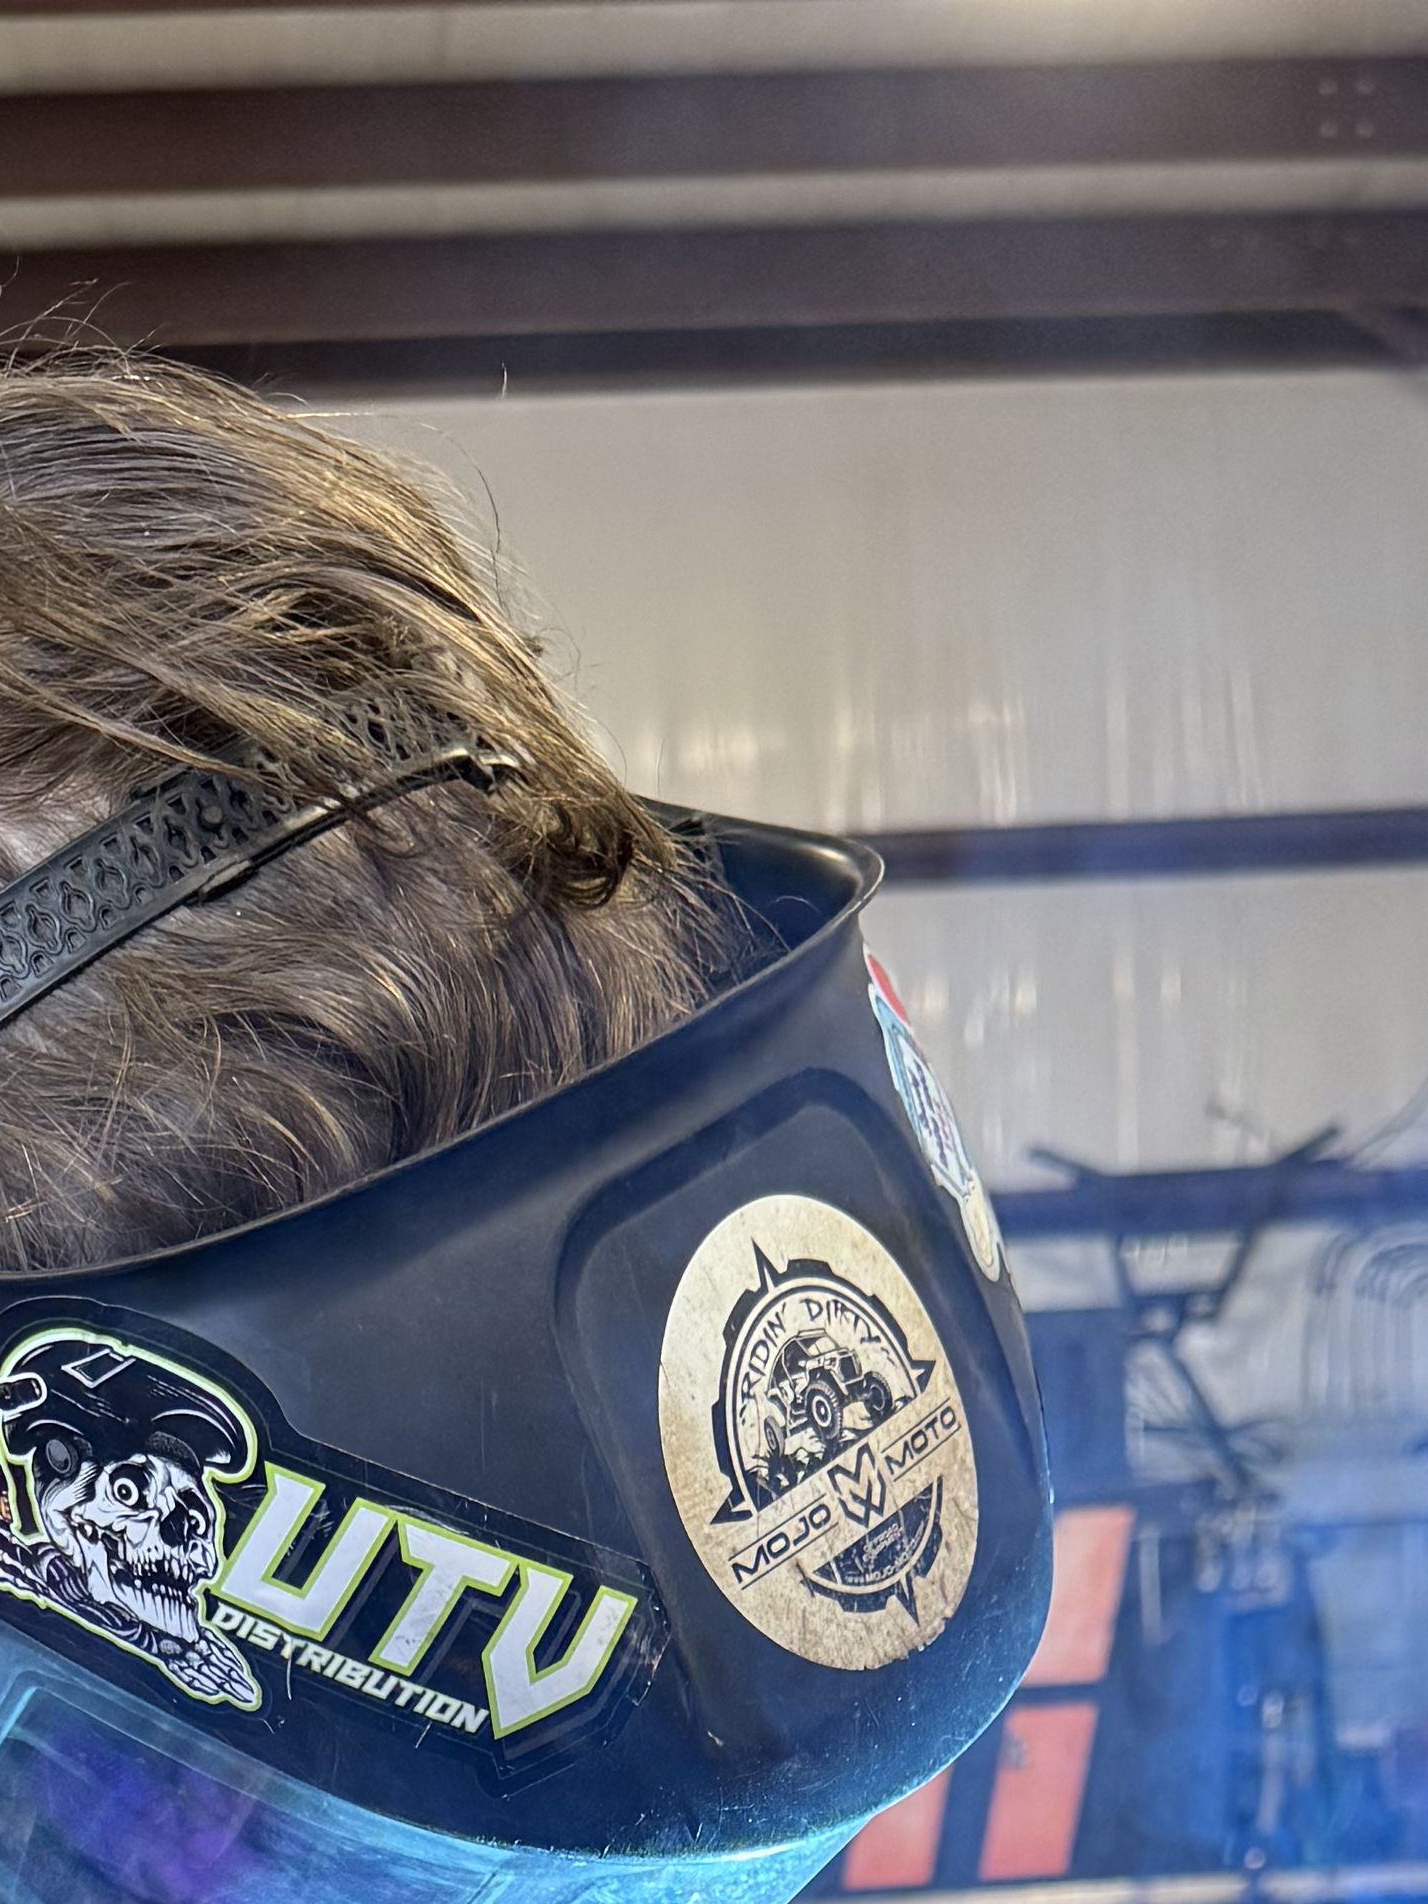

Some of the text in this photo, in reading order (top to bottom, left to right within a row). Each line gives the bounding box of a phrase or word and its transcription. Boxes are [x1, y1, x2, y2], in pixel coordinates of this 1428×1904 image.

[731, 1503, 832, 1584] MOJO
[884, 1406, 957, 1475] MOTO
[209, 1461, 639, 1741] UTV
[210, 1600, 490, 1734] DISTRIBUTION
